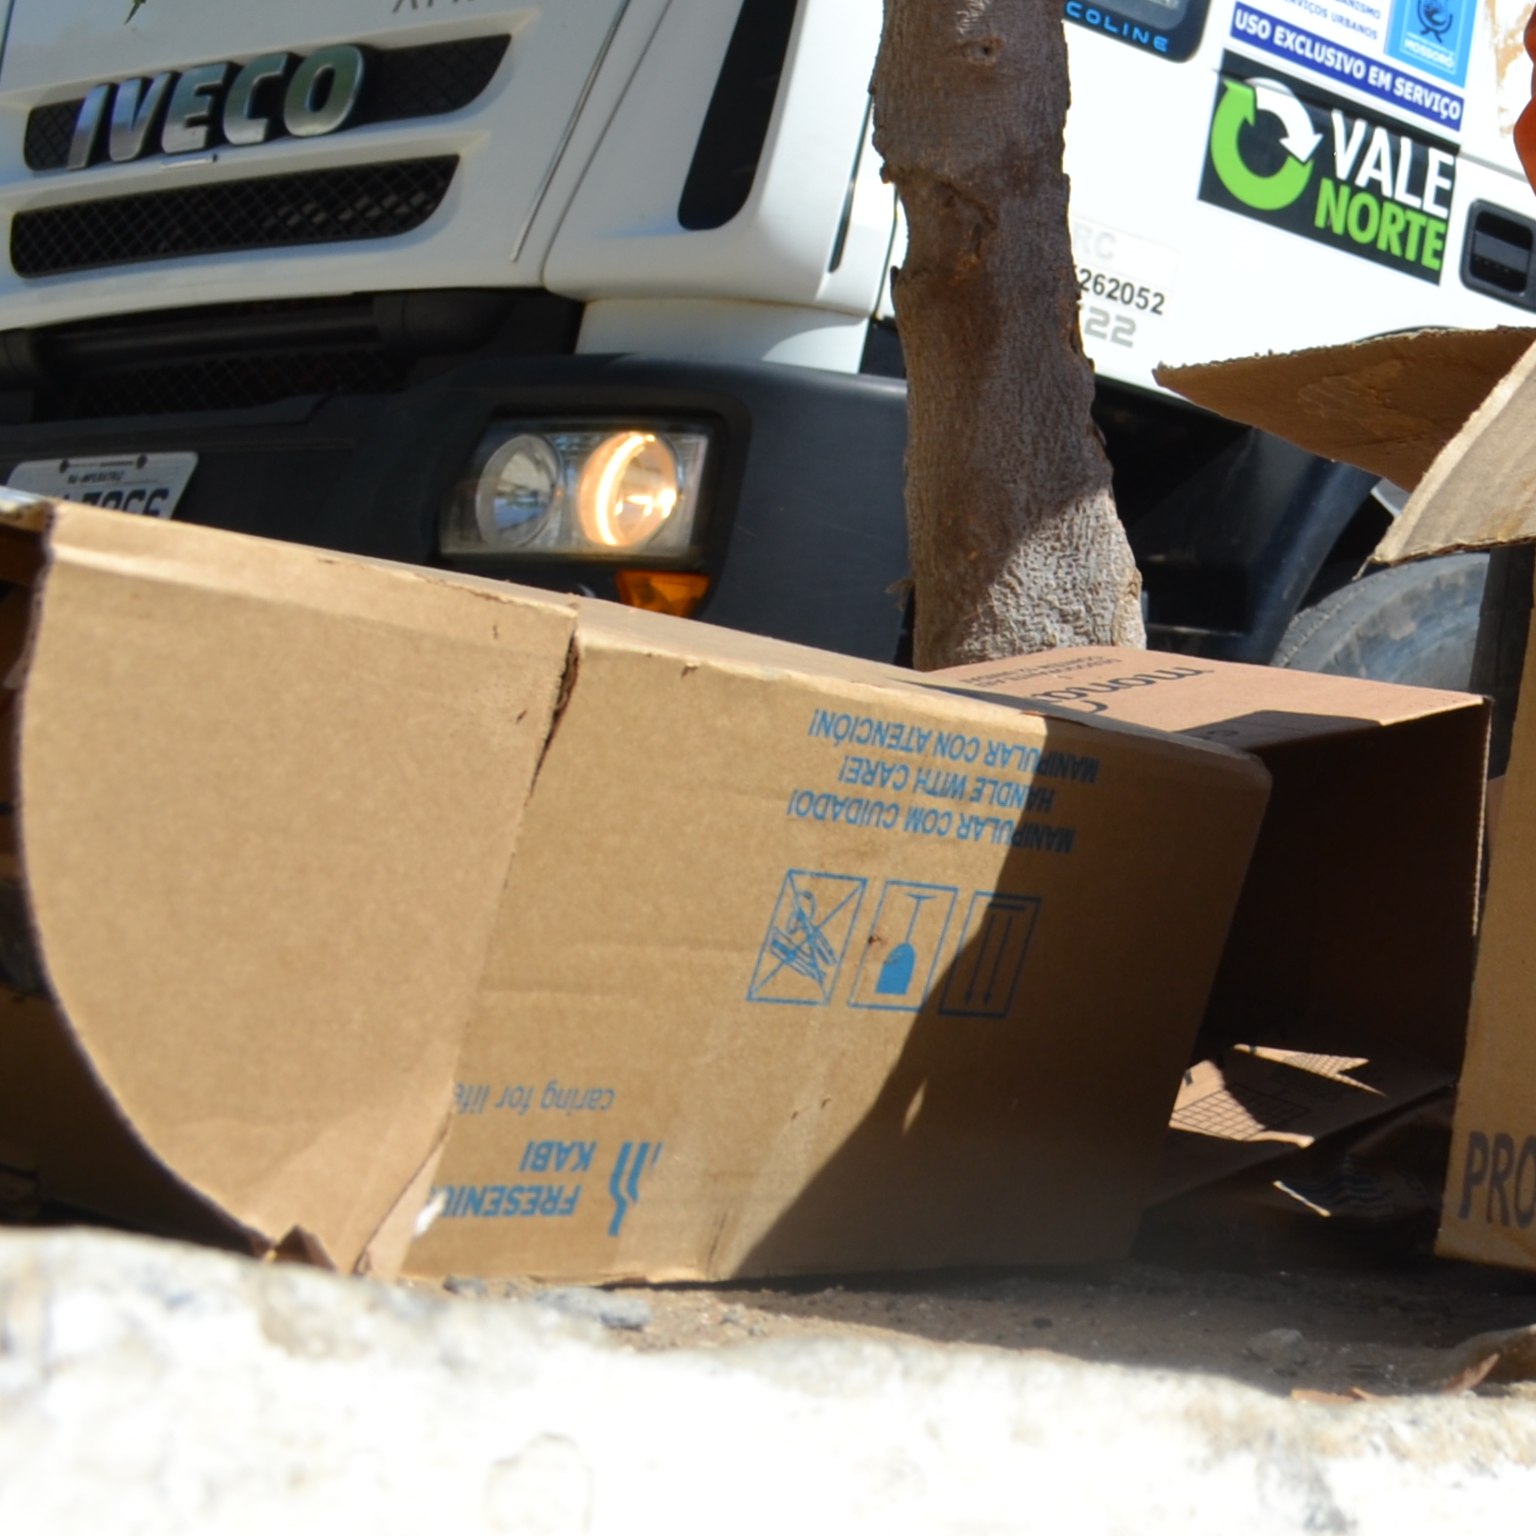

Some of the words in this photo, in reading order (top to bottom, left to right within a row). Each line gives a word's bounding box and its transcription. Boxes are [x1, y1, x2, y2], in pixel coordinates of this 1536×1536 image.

[1065, 0, 1170, 53] COLINE
[1330, 8, 1378, 40] URBANOS
[1234, 9, 1271, 41] USO
[1273, 26, 1366, 80] EXCLUSIVO
[1367, 63, 1391, 92] EM
[1393, 78, 1461, 120] SERVIÇO
[67, 43, 369, 170] IVECO
[1330, 109, 1457, 219] VALE
[1314, 177, 1445, 274] NORTE
[1079, 267, 1165, 316] 262052
[1084, 305, 1137, 349] 22
[808, 708, 934, 756] ATENCIÓN!
[933, 729, 981, 766] CON
[838, 754, 912, 792] CARE!
[986, 737, 1100, 785] MANIPULAR
[912, 766, 968, 802] WITH
[969, 775, 1057, 815] HANDLE
[787, 788, 902, 831] CUIDADO!
[903, 804, 954, 840] COM
[955, 809, 1077, 855] MANIPULAR
[494, 1085, 534, 1115] for
[540, 1080, 616, 1117] caring
[517, 1140, 599, 1173] KABI
